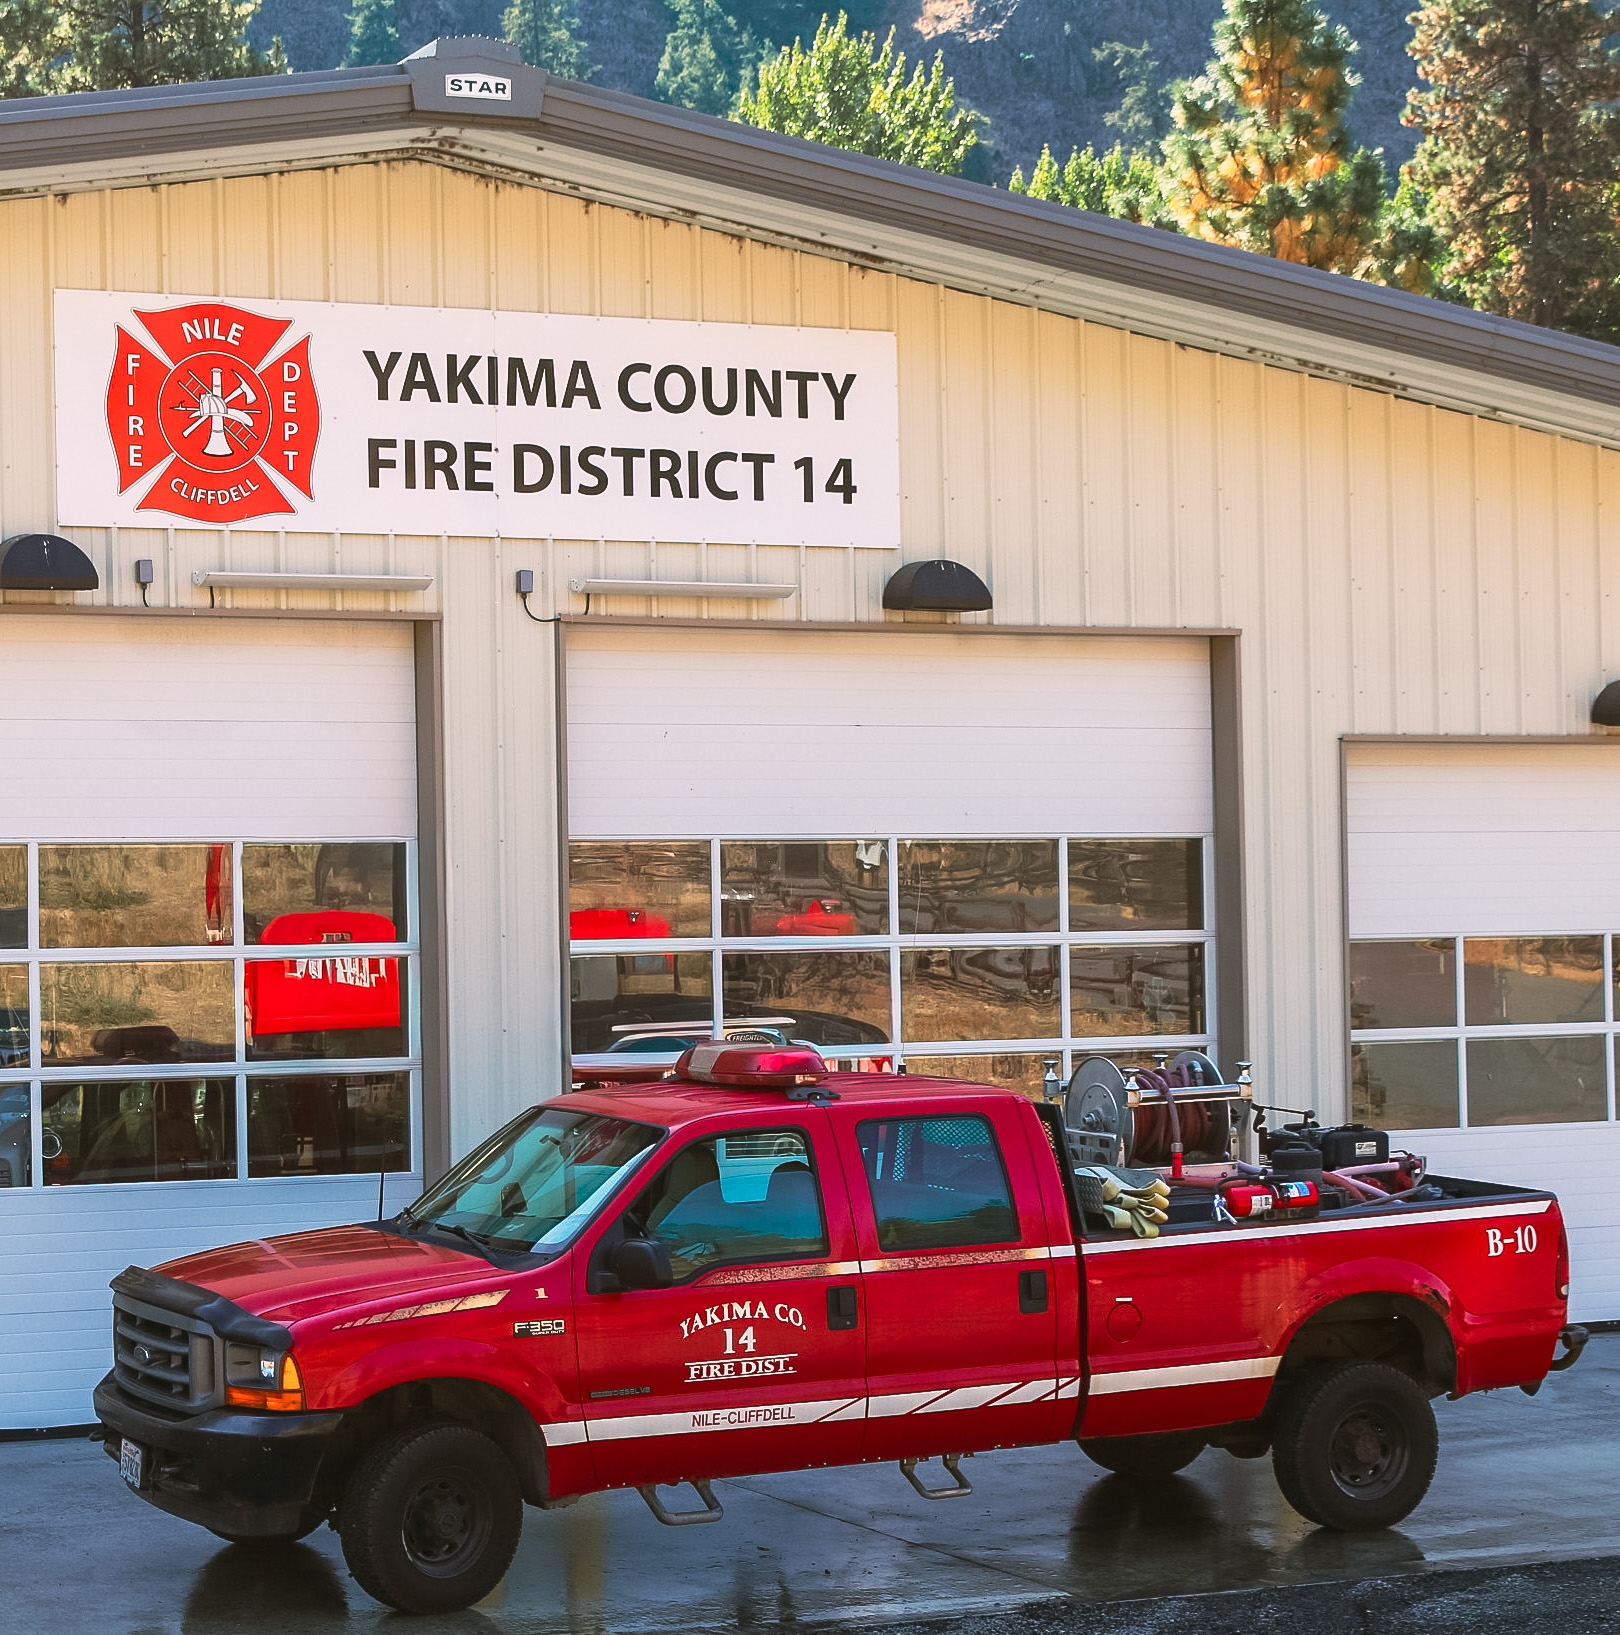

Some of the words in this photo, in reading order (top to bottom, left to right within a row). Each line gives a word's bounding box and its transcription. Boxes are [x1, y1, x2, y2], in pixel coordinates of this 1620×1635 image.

[450, 79, 507, 95] STAR
[181, 317, 245, 346] NILE
[362, 350, 602, 410] YAKIMA
[617, 362, 858, 421] COUNTY
[127, 353, 145, 467] FIRE
[282, 361, 302, 471] DEPT
[367, 438, 494, 492] FIRE
[513, 443, 775, 502] DISTRICT
[793, 456, 858, 505] 14
[170, 477, 260, 505] CLIFFDELL
[1485, 1224, 1538, 1257] B-10
[679, 1300, 770, 1340] YAKIMA
[774, 1303, 808, 1332] CO.
[723, 1326, 757, 1355] 14
[689, 1362, 736, 1380] FIRE
[740, 1357, 794, 1376] DIST.
[692, 1407, 796, 1428] NILE-CLIFFDELL
